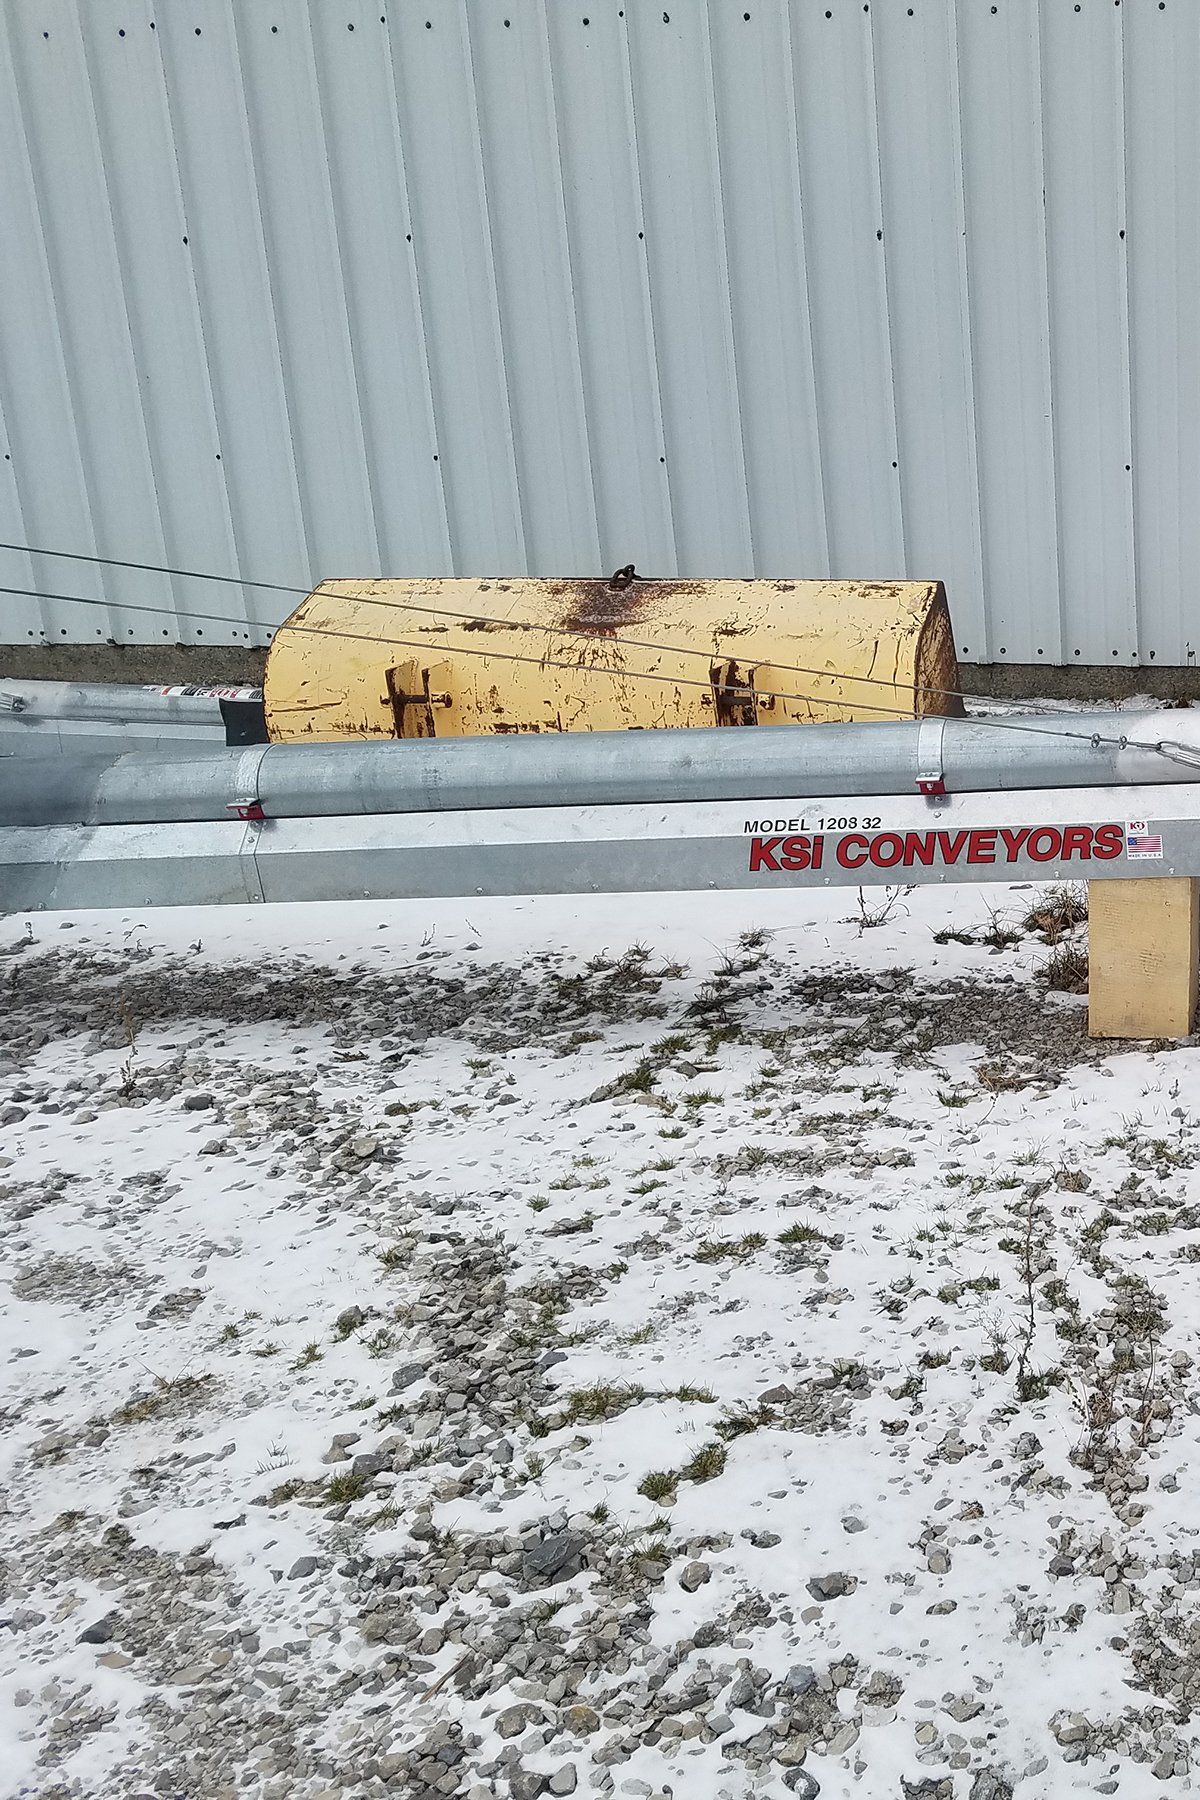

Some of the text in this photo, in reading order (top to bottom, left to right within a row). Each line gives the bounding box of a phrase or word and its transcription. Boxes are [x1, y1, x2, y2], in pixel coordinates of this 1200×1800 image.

[744, 816, 882, 833] MODEL 1208 32
[836, 824, 1124, 869] CONVEYORS
